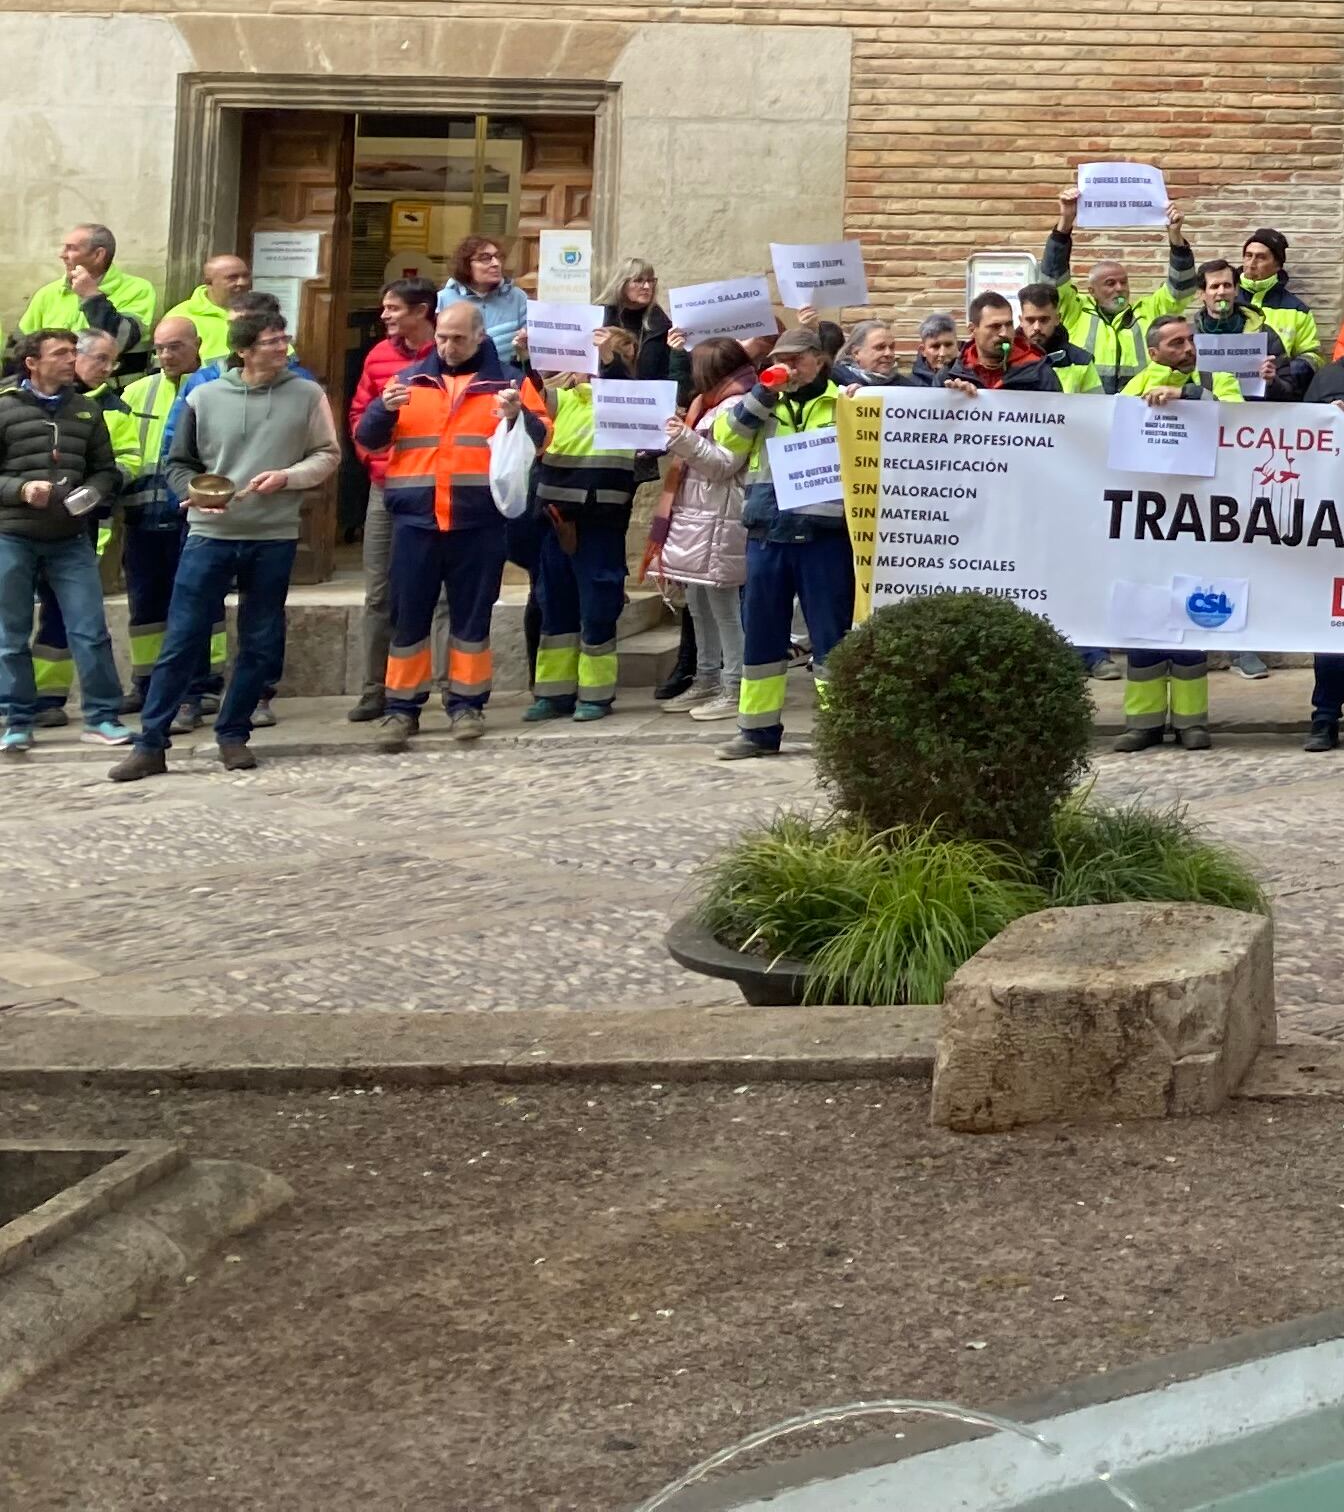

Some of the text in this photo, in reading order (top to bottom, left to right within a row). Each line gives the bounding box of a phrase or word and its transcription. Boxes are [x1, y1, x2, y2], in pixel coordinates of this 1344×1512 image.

[856, 406, 1066, 425] SIN CONCILIACIÓN FAMILIAR
[856, 429, 1055, 448] SIN CARRERA PROFESIONAL
[1217, 426, 1340, 456] LCALDE,
[854, 456, 1008, 473] SIN RECLASIFICACIÓN
[852, 483, 977, 499] SIN VALORACIÓN
[851, 507, 950, 522] SIN MATERIAL
[879, 531, 960, 545] VESTUARIO
[876, 555, 944, 568] MEJORAS
[949, 558, 1016, 571] SOCIALES
[874, 582, 956, 595] PROVISIÓN
[1189, 592, 1232, 613] CSL
